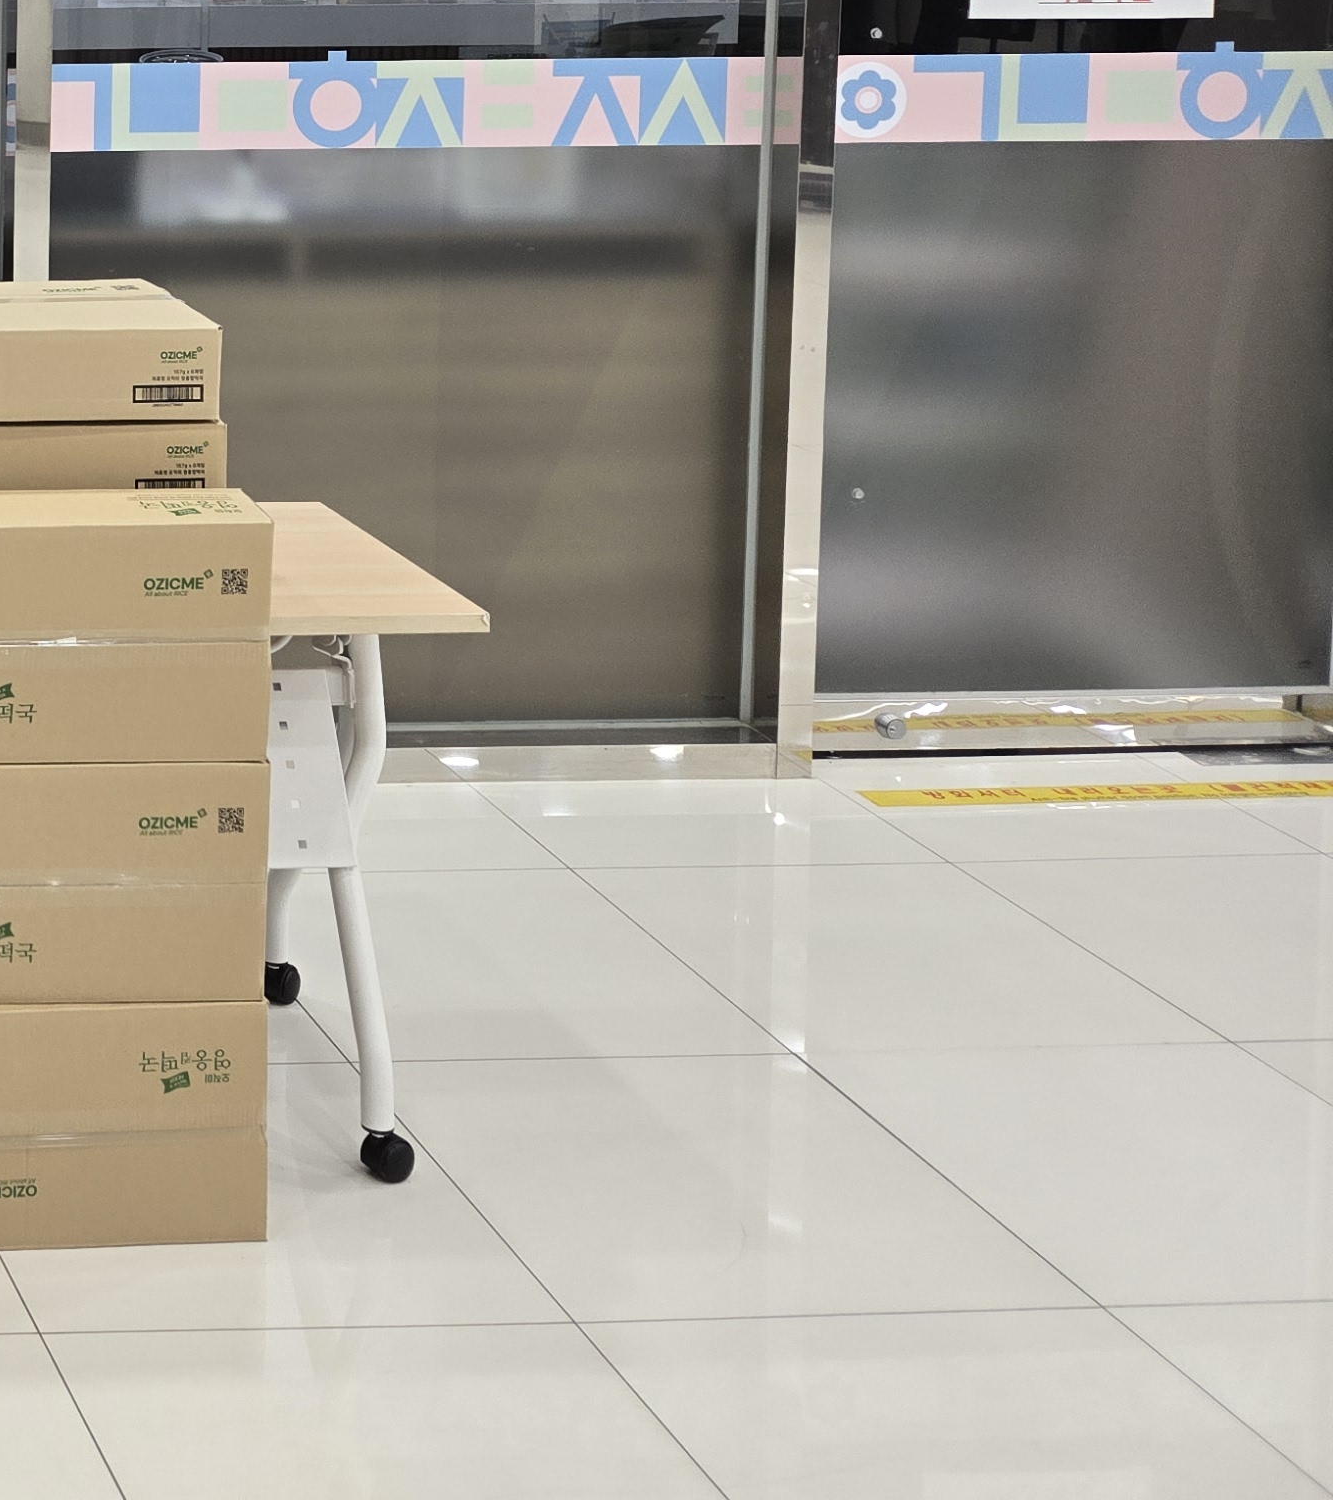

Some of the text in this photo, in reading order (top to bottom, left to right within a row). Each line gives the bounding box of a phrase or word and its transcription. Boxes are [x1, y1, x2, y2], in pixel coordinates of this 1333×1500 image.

[161, 351, 197, 360] OZICME
[144, 578, 204, 590] OZICME
[139, 816, 198, 829] OZICME
